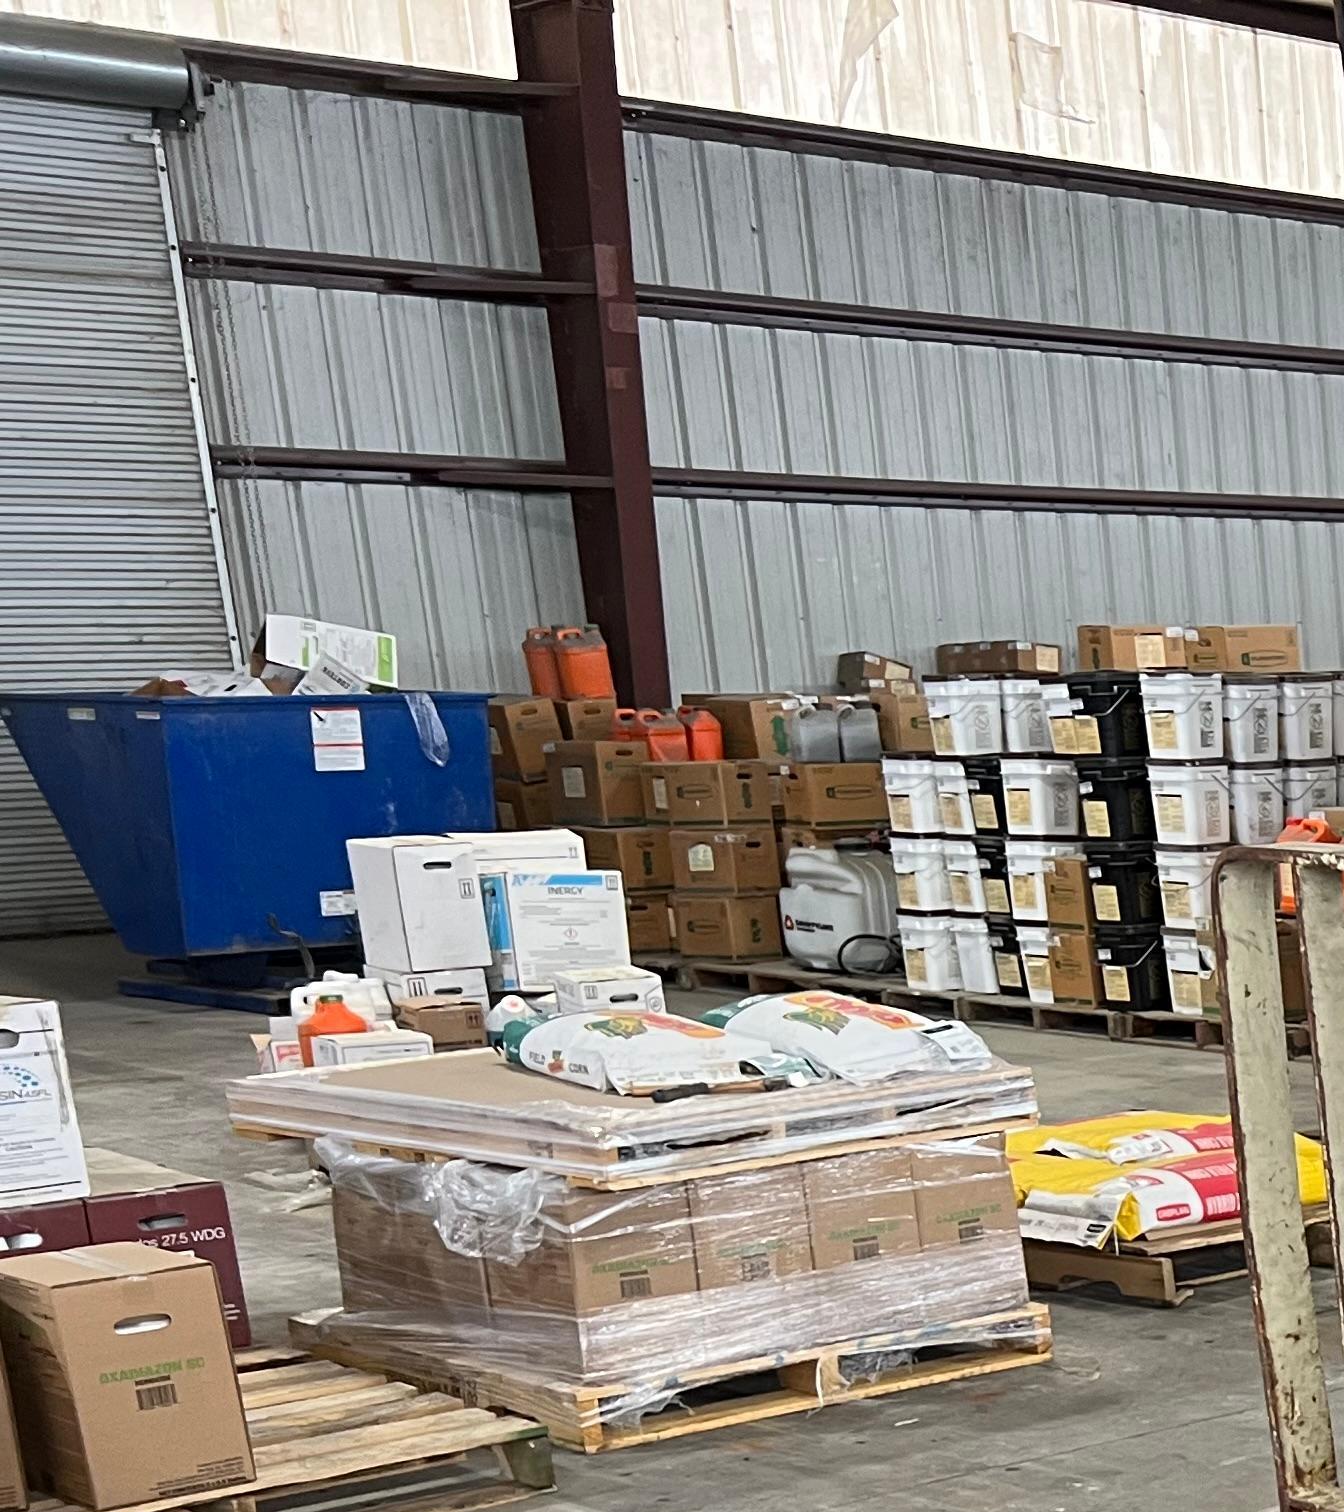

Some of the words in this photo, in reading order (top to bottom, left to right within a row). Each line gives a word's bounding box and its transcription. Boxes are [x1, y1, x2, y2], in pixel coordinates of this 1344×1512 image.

[568, 1062, 590, 1075] CORN
[161, 1232, 189, 1247] 27.5
[190, 1226, 226, 1242] WDG
